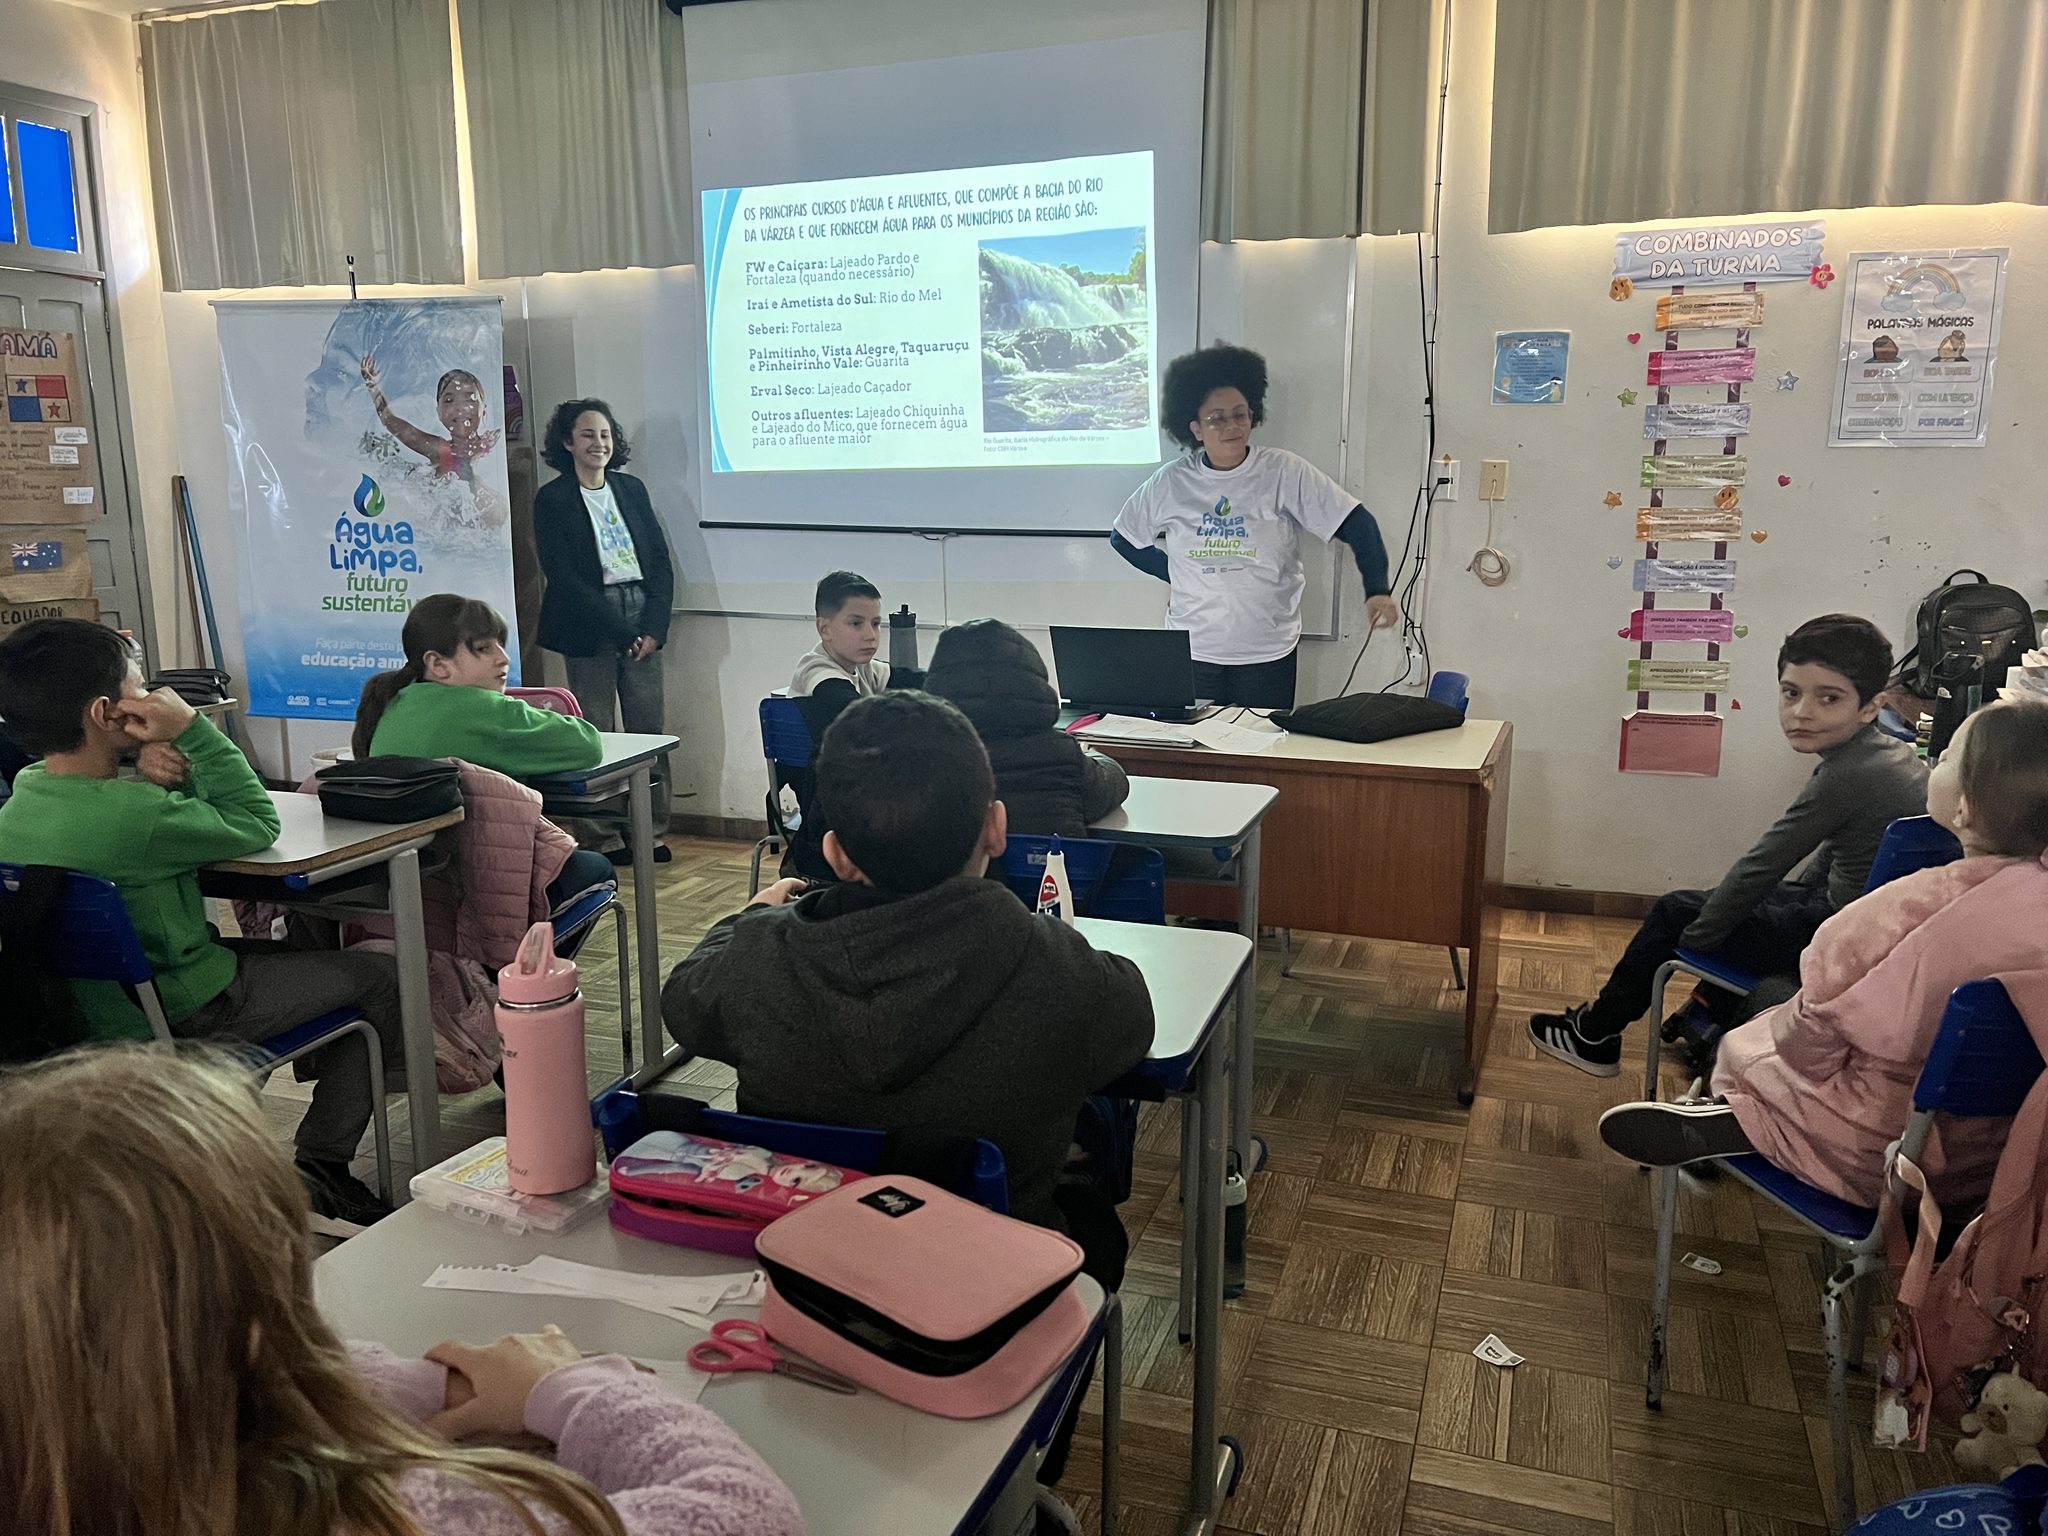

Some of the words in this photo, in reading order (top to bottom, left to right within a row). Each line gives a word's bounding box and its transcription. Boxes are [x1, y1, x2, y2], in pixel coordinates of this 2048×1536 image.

[744, 207, 756, 221] OS
[759, 203, 808, 220] PRINCIPAIS
[812, 200, 847, 216] CURSOS
[850, 196, 884, 213] D'ÁGUA
[888, 196, 894, 210] E
[897, 191, 951, 209] AFLUENTES,
[955, 189, 974, 205] QUE
[978, 184, 1019, 203] COMPÕE
[1023, 185, 1031, 199] A
[1035, 182, 1064, 199] BACIA
[1068, 179, 1082, 194] DO
[1086, 177, 1104, 193] RIO
[744, 228, 757, 242] DA
[761, 226, 795, 242] VÁRZEA
[799, 225, 804, 239] E
[808, 223, 827, 239] QUE
[830, 220, 879, 237] FORNECEM
[883, 216, 908, 233] ÁGUA
[912, 215, 936, 231] PARA
[940, 214, 953, 229] OS
[957, 208, 1013, 227] MUNICÍPIOS
[1018, 206, 1032, 223] DA
[1036, 203, 1071, 221] REGIÃO
[1075, 200, 1098, 218] SÃO:
[1635, 227, 1802, 257] COMBINADOS
[745, 262, 766, 273] FW
[768, 263, 775, 272] e
[777, 260, 828, 275] Caiçara:
[830, 256, 874, 271] Lajeado
[877, 252, 910, 266] Pardo
[913, 254, 920, 263] e
[1650, 259, 1685, 280] DA
[1692, 253, 1782, 277] TURMA
[746, 273, 797, 286] Fortaleza
[799, 269, 846, 286] (quando
[848, 264, 915, 280] necessário)
[747, 299, 769, 310] Iraí
[771, 300, 778, 309] e
[780, 295, 834, 309] Ametista
[837, 294, 851, 306] do
[854, 292, 876, 305] Sul:
[879, 291, 898, 304] Rio
[901, 290, 916, 302] do
[918, 288, 942, 302] Mel
[748, 322, 789, 335] Seberi:
[791, 320, 842, 334] Fortaleza
[1927, 314, 1974, 328] MÁGICAS
[0, 332, 57, 359] AMÁ
[749, 347, 820, 361] Palmitinho,
[822, 345, 851, 357] Vista
[855, 343, 899, 357] Alegre,
[900, 341, 969, 355] Taquaruçu
[750, 363, 756, 372] e
[758, 358, 831, 372] Pinheirinho
[833, 357, 863, 369] Vale:
[865, 356, 909, 368] Guarita
[750, 384, 782, 397] Erval
[785, 384, 815, 396] Seco:
[817, 382, 861, 397] Lajeado
[864, 380, 912, 395] Caçador
[751, 410, 791, 422] Outros
[794, 408, 853, 421] afluentes:
[856, 406, 900, 420] Lajeado
[903, 403, 964, 420] Chiquinha
[752, 424, 758, 434] e
[761, 420, 804, 436] Lajeado
[806, 420, 820, 433] do
[881, 417, 937, 431] fornecem
[940, 416, 968, 431] água
[752, 436, 777, 449] para
[779, 436, 786, 445] o
[788, 433, 835, 446] afluente
[838, 432, 871, 444] maior
[335, 511, 414, 549] Água
[1196, 526, 1249, 540] Limpa,
[1204, 537, 1241, 549] futuro
[330, 543, 423, 577] Limpa,
[347, 571, 409, 593] futuro
[321, 593, 412, 613] sustentáv
[315, 638, 338, 650] Faça
[340, 640, 366, 651] parte
[366, 640, 396, 651] deste
[301, 651, 376, 671] educação
